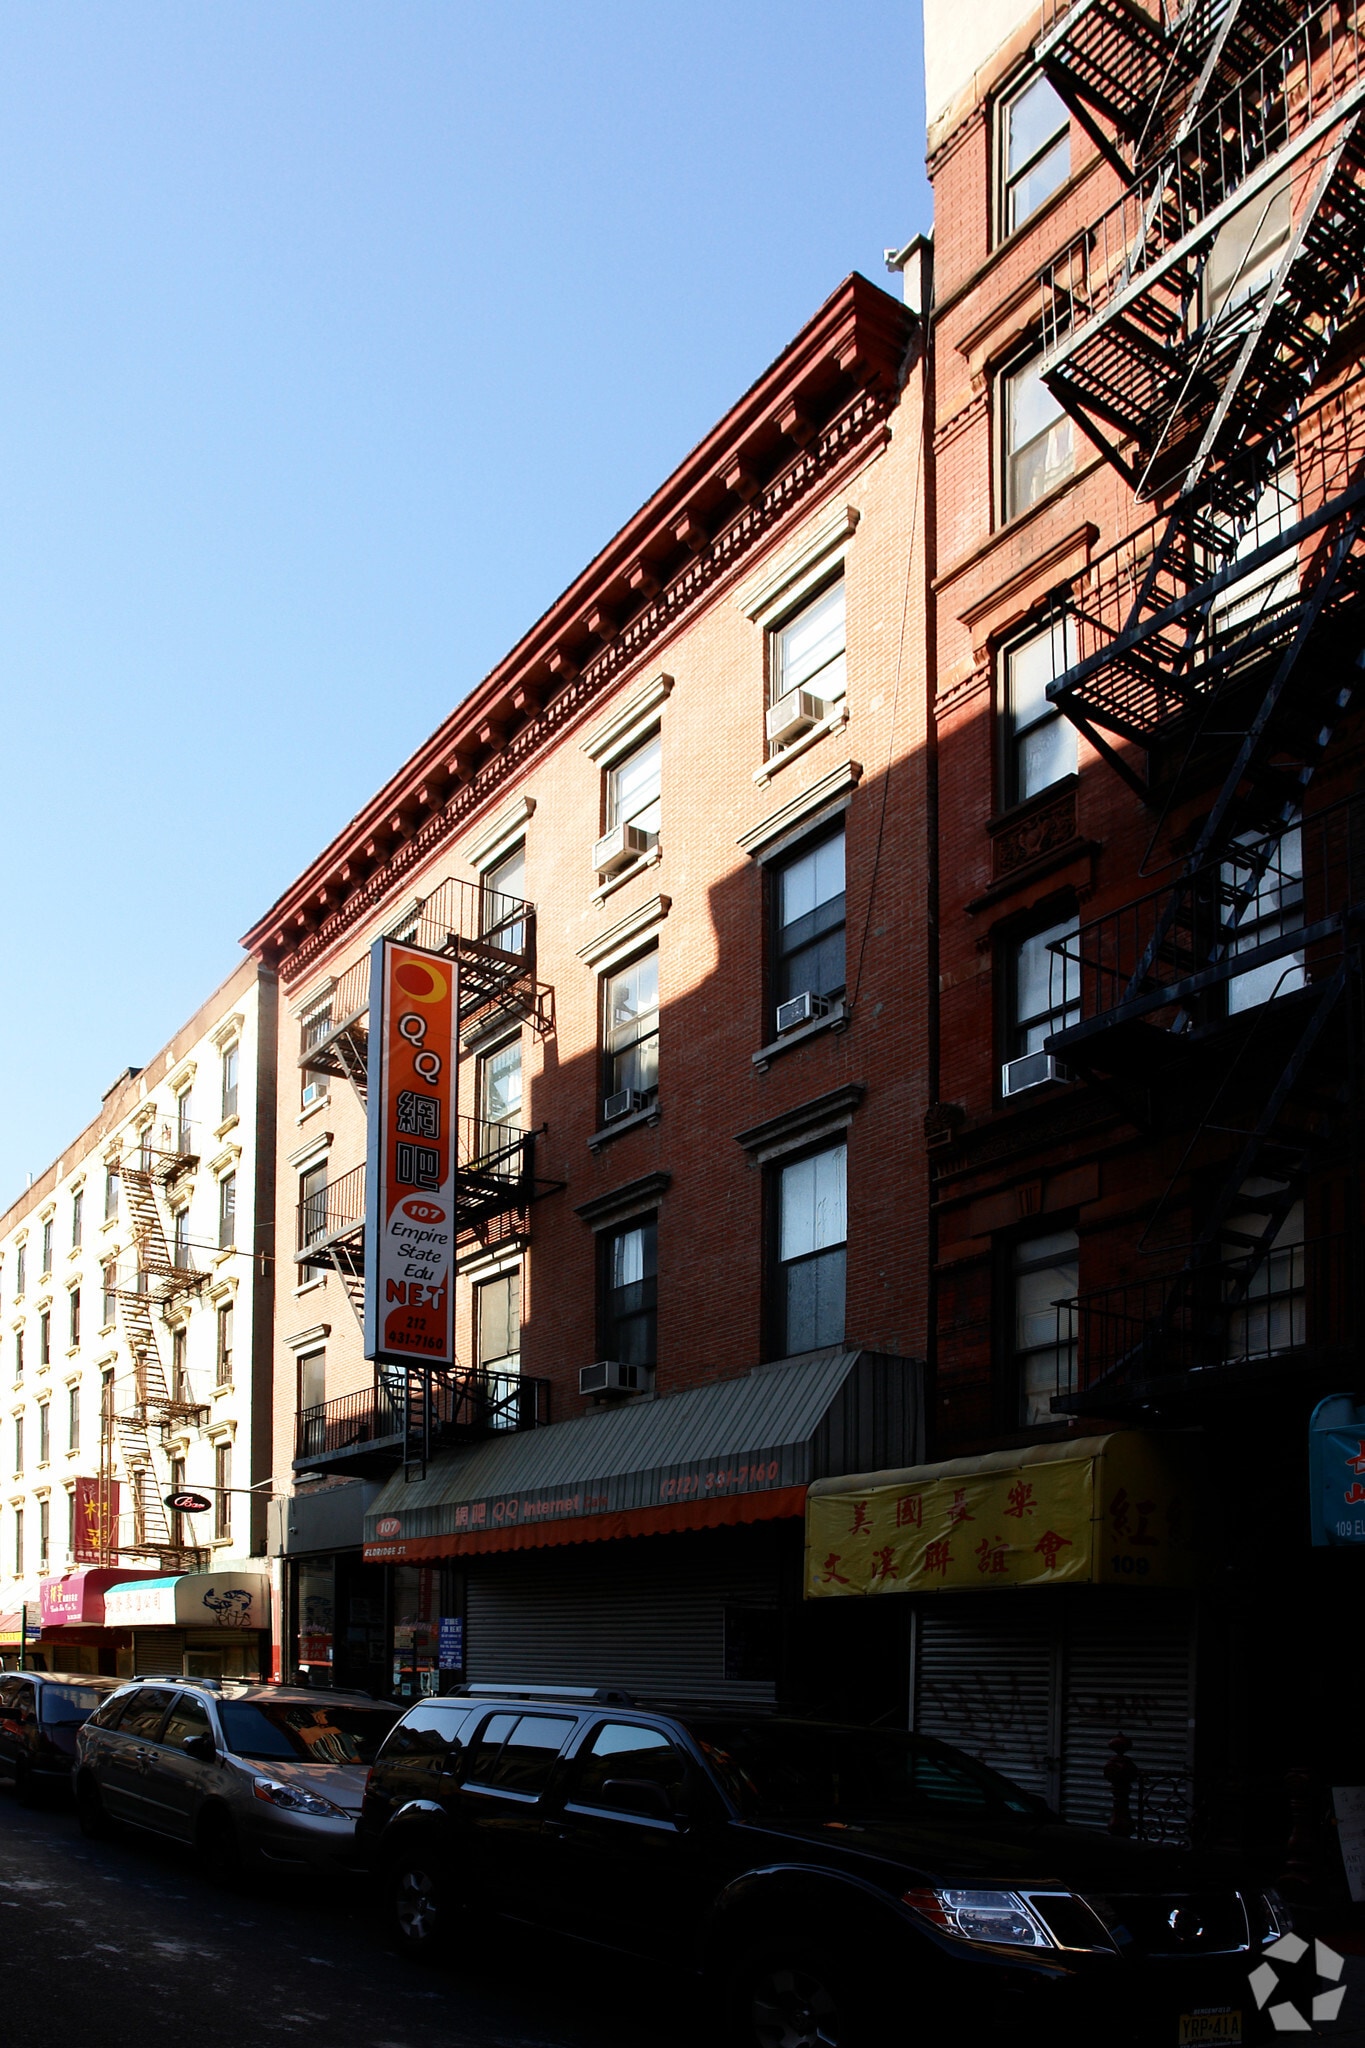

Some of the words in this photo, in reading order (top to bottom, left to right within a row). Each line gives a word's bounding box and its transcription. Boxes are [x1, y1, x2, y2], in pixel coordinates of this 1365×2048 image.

[397, 1090, 440, 1193] 網吧
[411, 1204, 441, 1220] 107
[391, 1222, 448, 1245] Empire
[397, 1243, 442, 1263] State
[404, 1263, 434, 1281] Edu
[386, 1278, 445, 1310] NET
[406, 1316, 426, 1331] 212
[388, 1330, 444, 1350] 431-7160
[659, 1474, 699, 1498] (212)
[455, 1502, 487, 1527] 網吧
[492, 1499, 519, 1522] QQ
[523, 1494, 580, 1517] Internet
[848, 1479, 1038, 1535] 美國長樂
[380, 1520, 398, 1534] 107
[1335, 1521, 1352, 1536] 109
[1111, 1556, 1149, 1574] 109
